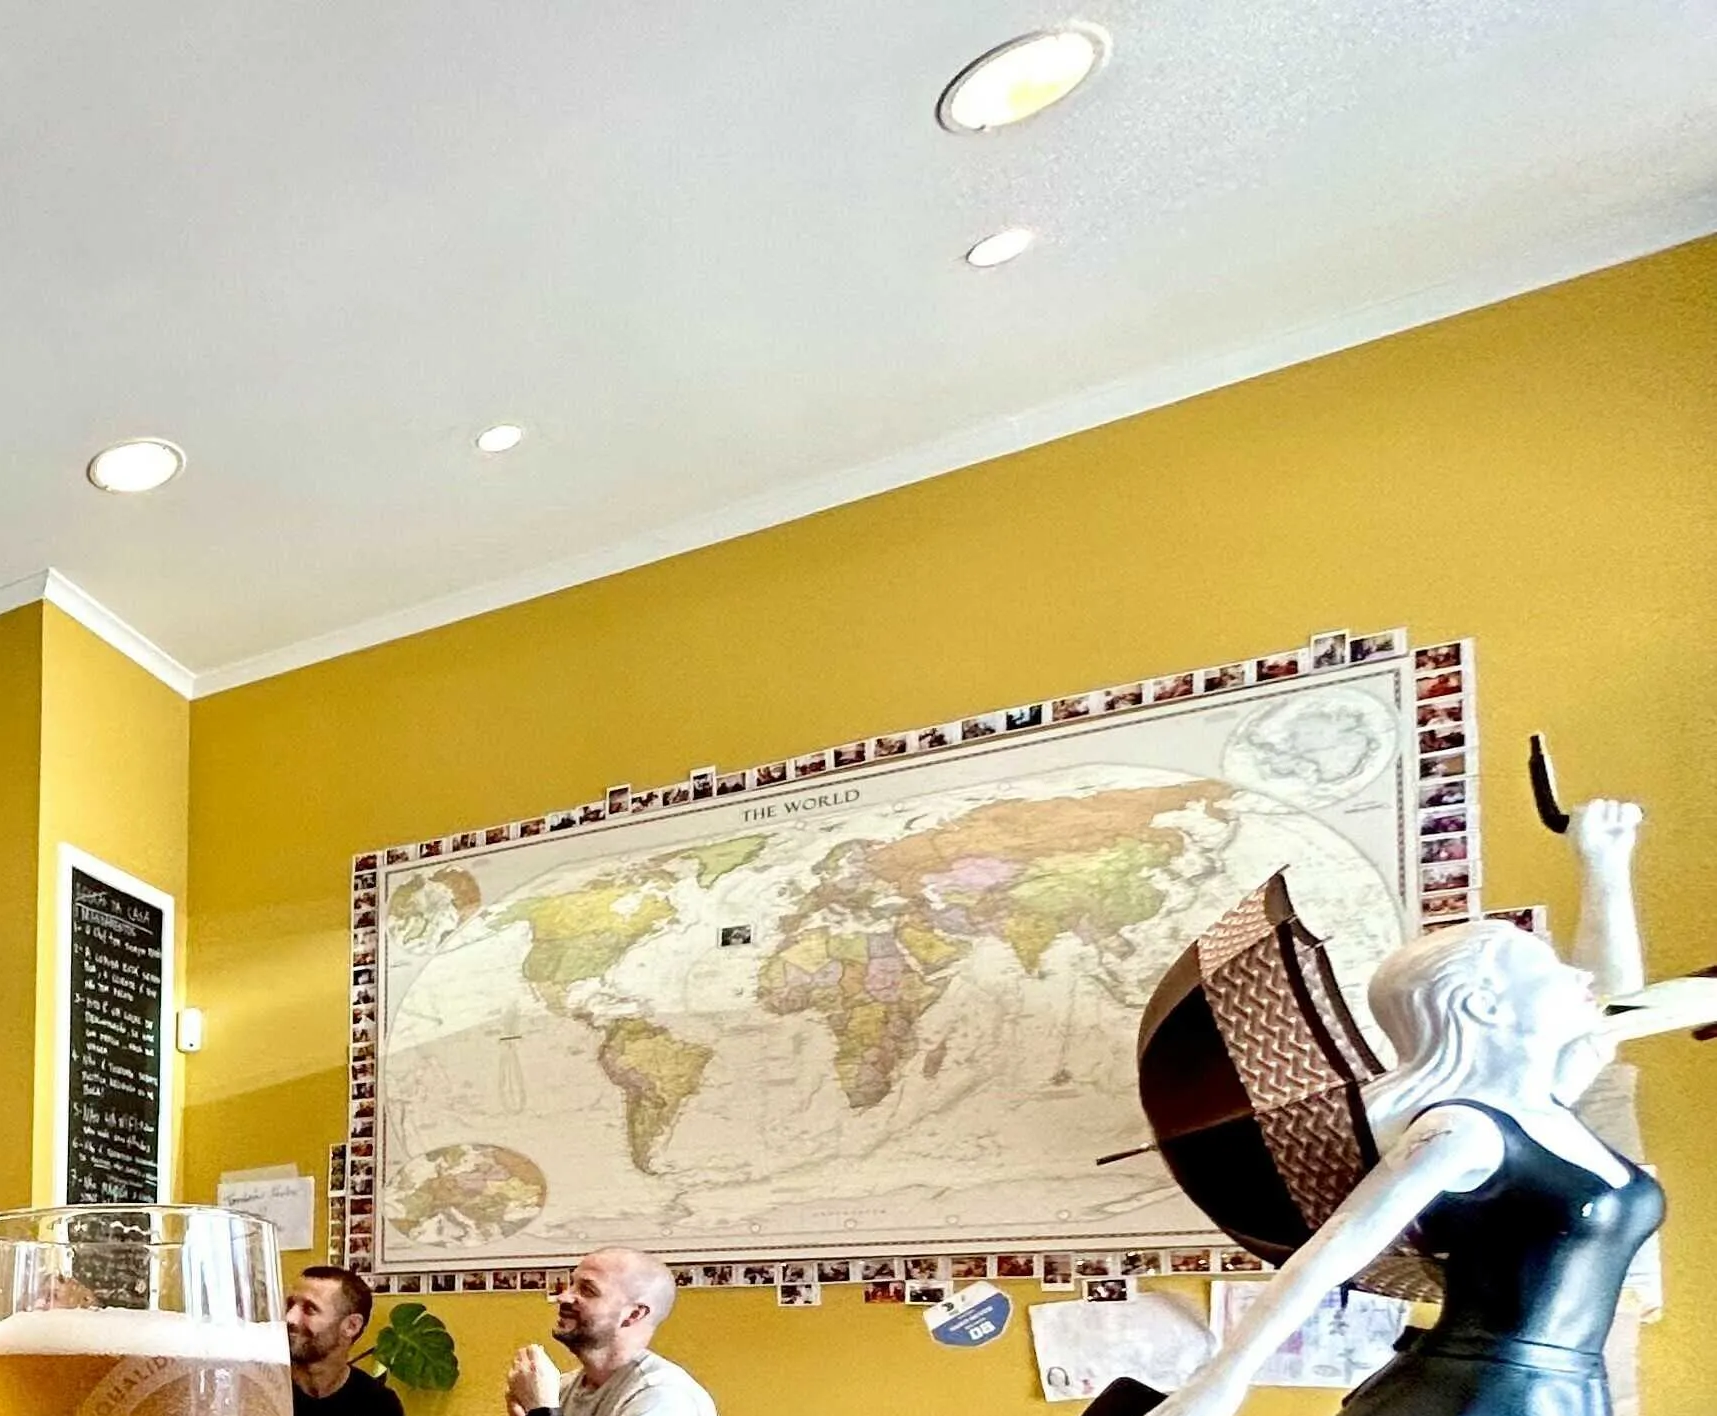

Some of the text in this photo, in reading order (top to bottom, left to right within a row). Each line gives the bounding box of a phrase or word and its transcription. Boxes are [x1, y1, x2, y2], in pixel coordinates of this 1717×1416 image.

[742, 788, 860, 822] THE WORLD
[94, 1354, 178, 1416] QUALID
